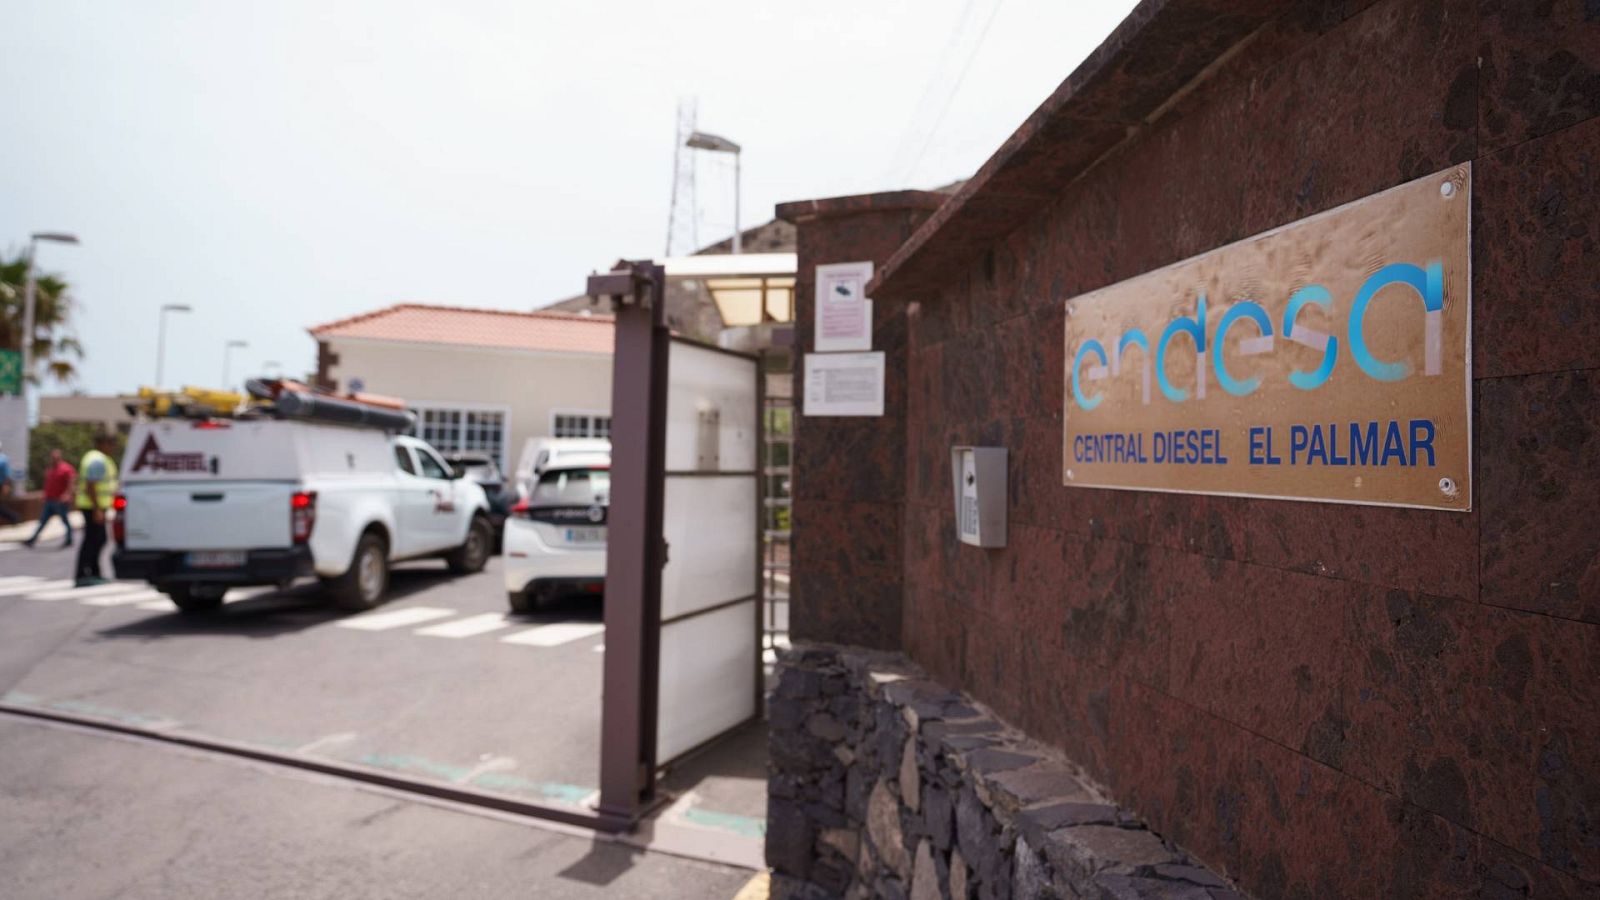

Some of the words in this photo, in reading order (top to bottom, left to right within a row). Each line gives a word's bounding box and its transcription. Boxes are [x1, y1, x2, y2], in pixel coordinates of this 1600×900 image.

[1072, 257, 1444, 411] endesa
[1073, 432, 1147, 464] CENTRAL
[1153, 428, 1227, 465] DIESEL
[1249, 426, 1281, 465] EL
[1290, 419, 1436, 467] PALMAR
